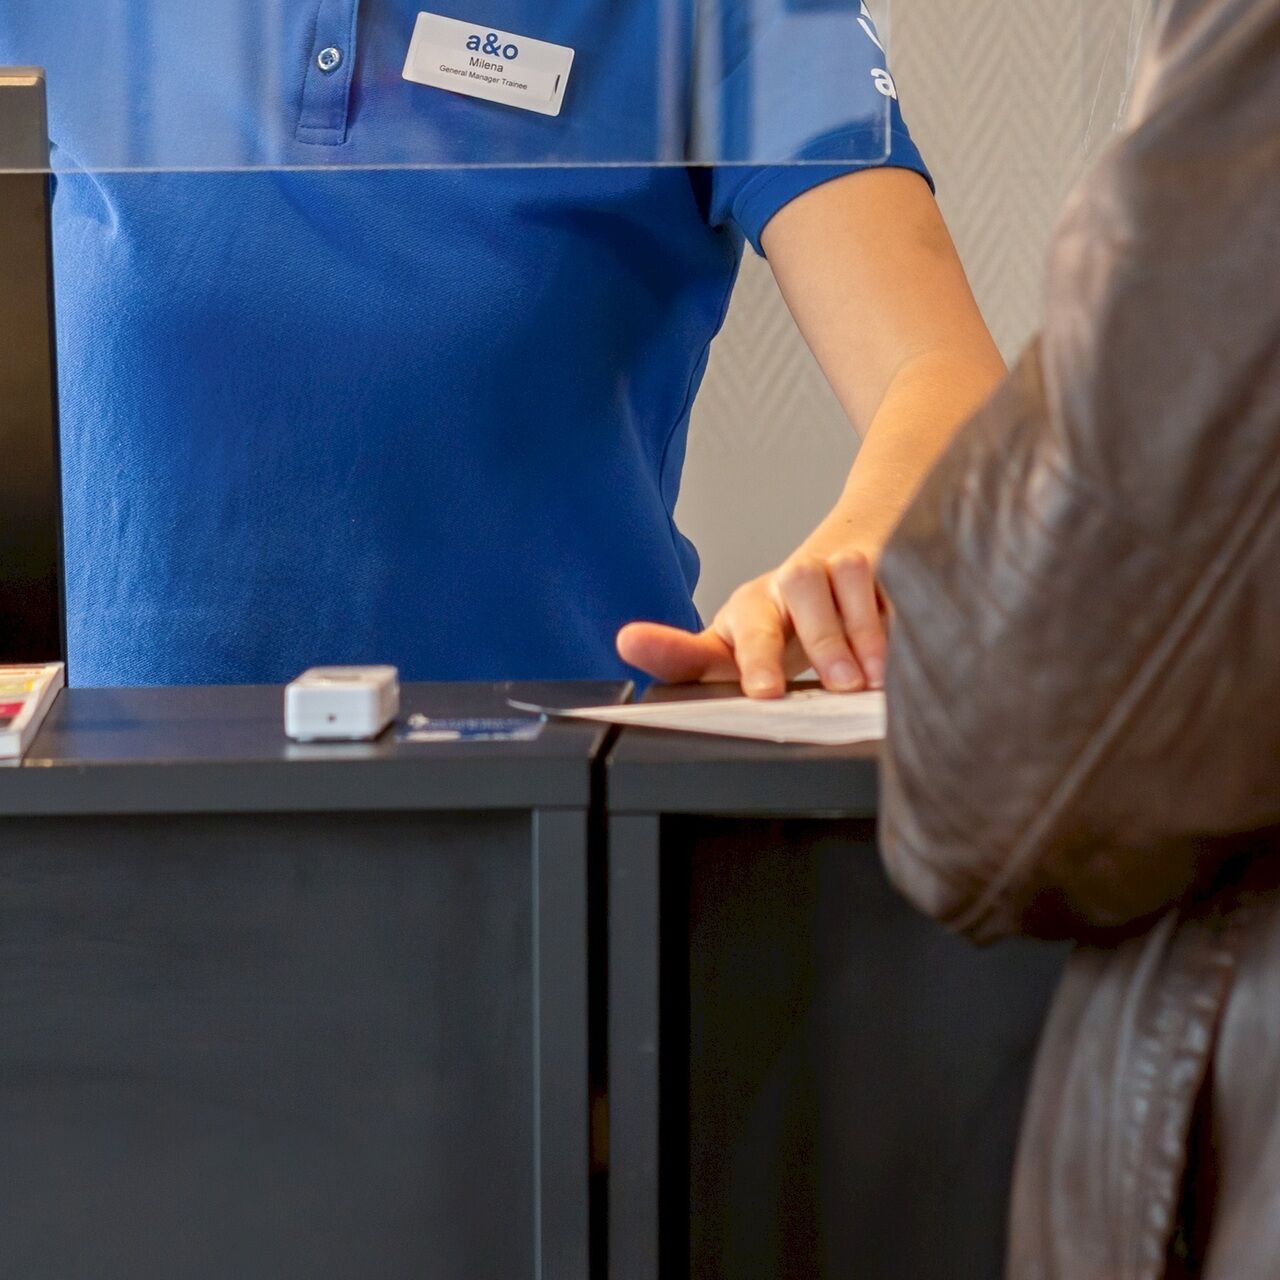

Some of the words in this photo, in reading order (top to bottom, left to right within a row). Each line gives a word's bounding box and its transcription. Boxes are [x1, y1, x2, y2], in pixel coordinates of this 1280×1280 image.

[466, 32, 519, 60] a&o
[439, 64, 468, 77] General
[468, 71, 500, 85] Manager
[502, 78, 528, 90] Trainee
[469, 57, 504, 73] Milena
